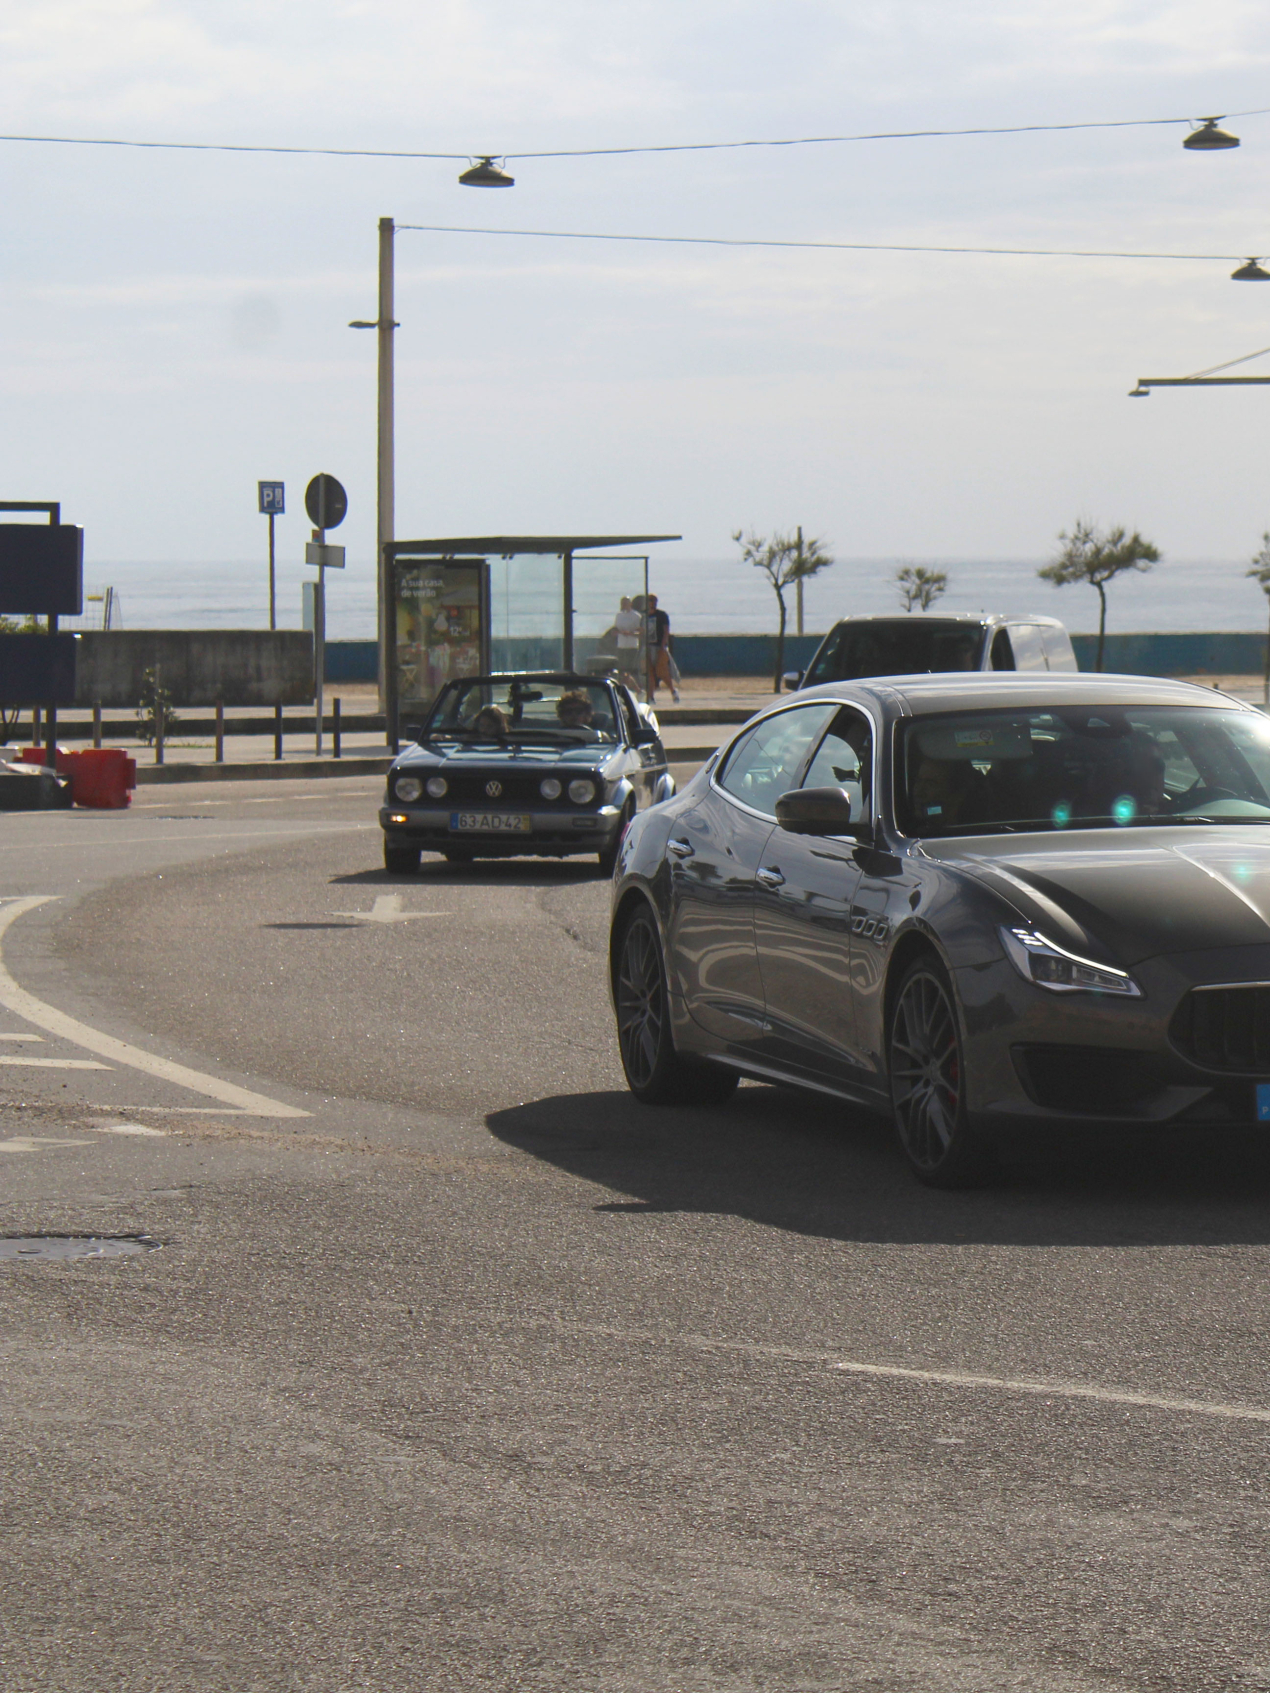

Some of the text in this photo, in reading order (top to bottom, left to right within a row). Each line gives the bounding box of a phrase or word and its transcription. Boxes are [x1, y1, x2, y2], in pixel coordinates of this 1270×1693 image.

[263, 490, 273, 507] P
[401, 588, 411, 597] de
[1262, 1106, 1269, 1115] P
